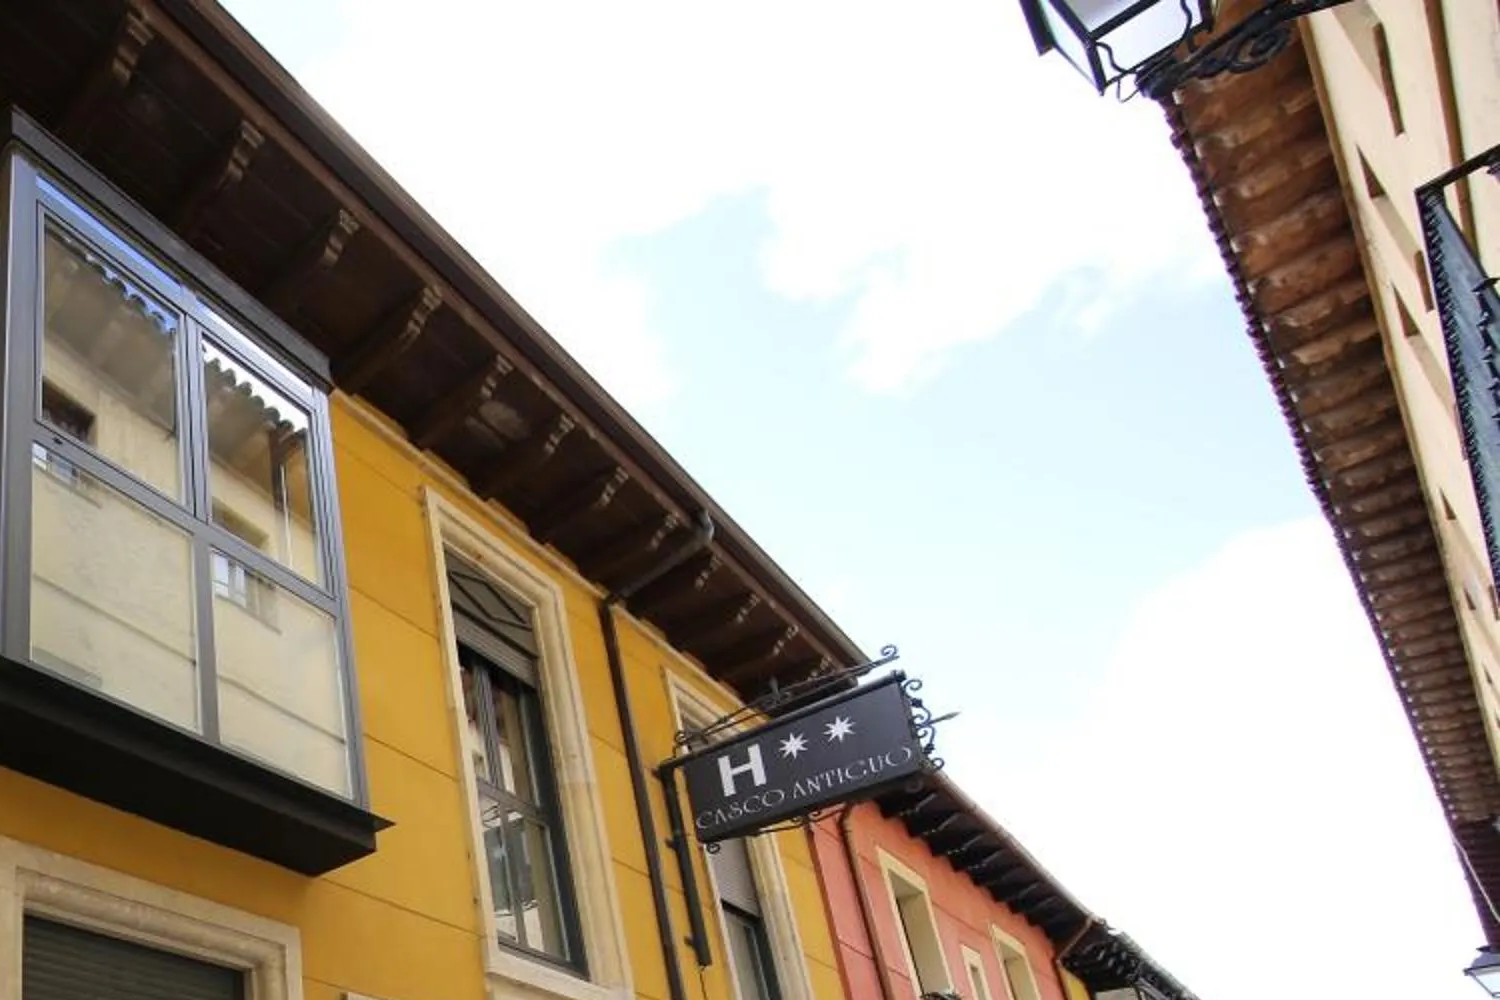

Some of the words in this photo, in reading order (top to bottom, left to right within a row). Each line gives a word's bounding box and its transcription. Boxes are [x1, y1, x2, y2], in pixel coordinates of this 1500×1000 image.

[695, 788, 785, 830] CASCO
[793, 746, 913, 800] ANTIGUO
[717, 743, 767, 797] H
